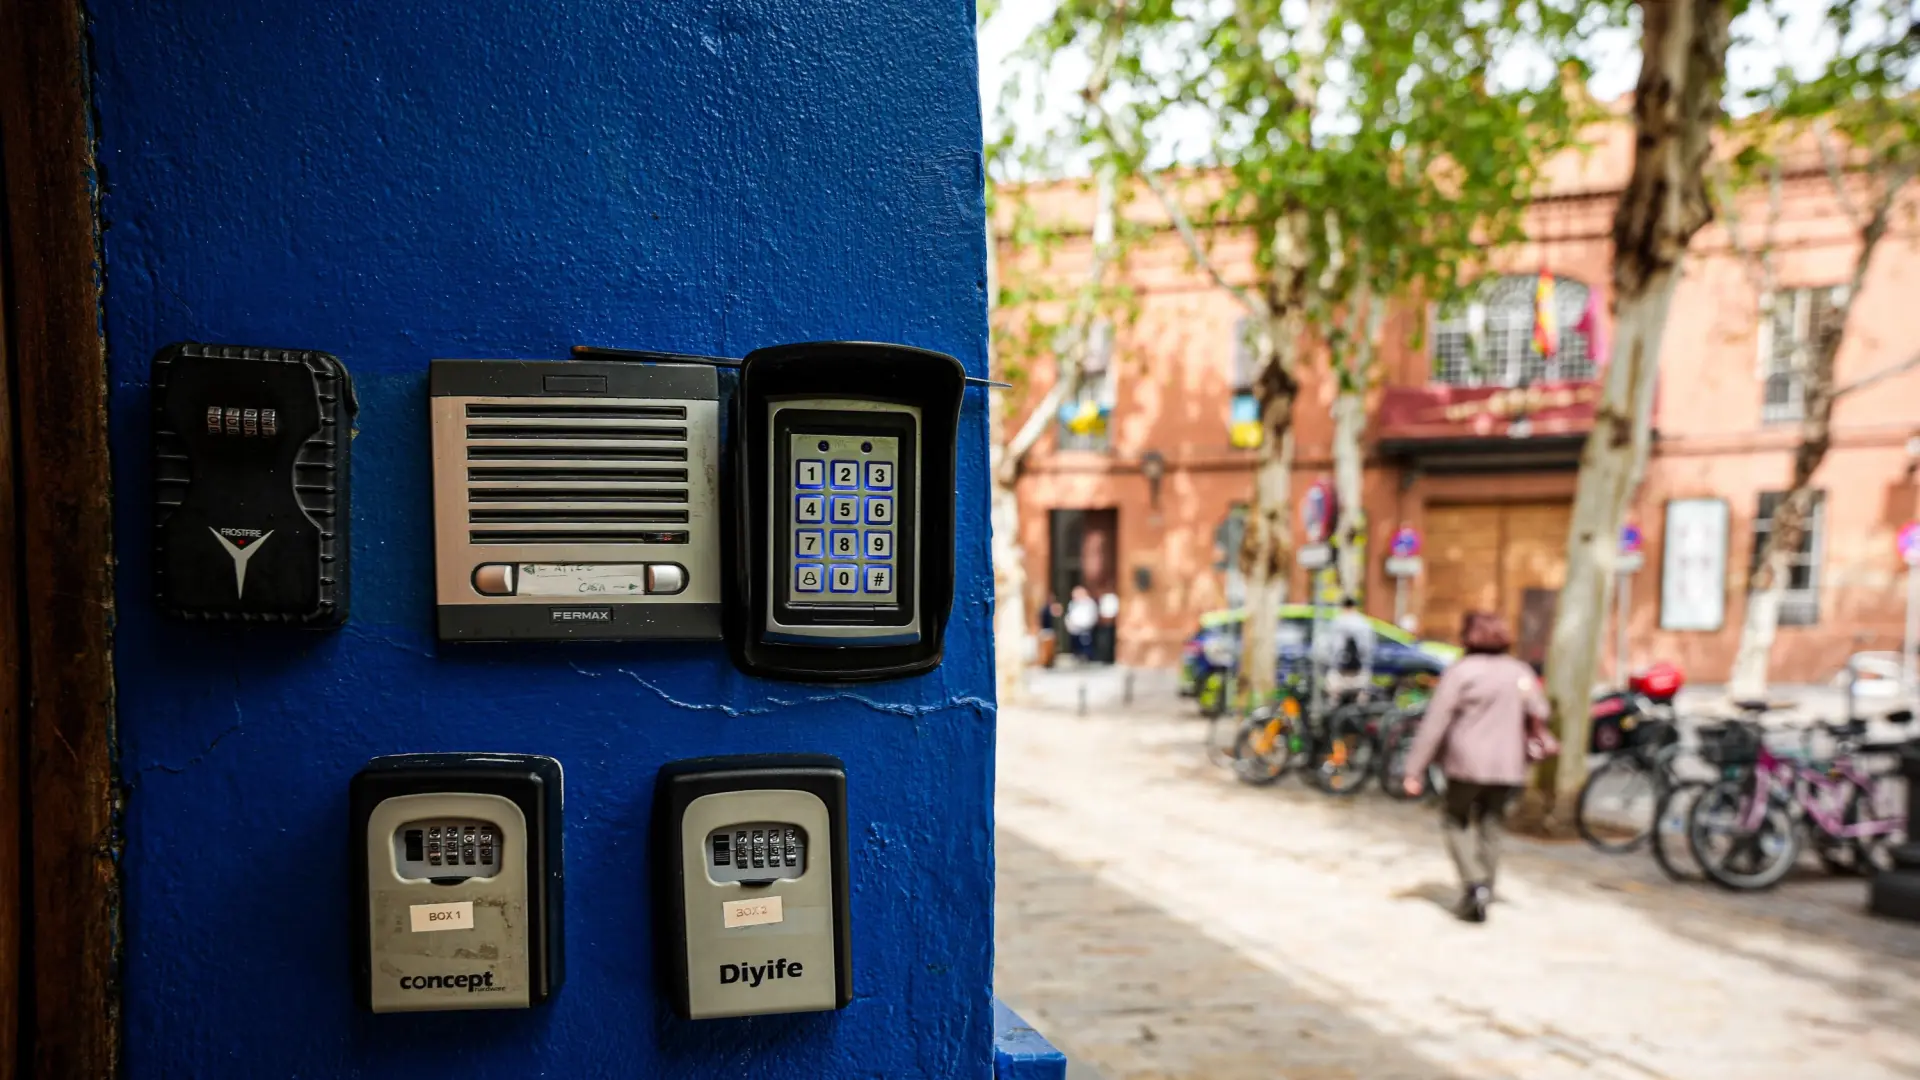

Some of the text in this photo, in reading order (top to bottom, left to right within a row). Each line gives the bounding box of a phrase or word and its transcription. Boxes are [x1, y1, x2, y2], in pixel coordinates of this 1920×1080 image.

[806, 466, 885, 483] 1 2 3
[805, 502, 885, 517] 4 5 6
[221, 527, 262, 537] FROSTFIRE
[805, 537, 884, 551] 7 8 9
[839, 571, 885, 586] 0 #
[552, 611, 609, 621] FERMAX
[429, 911, 461, 921] BOX 1
[761, 906, 767, 915] 2
[719, 958, 803, 988] Diyife
[399, 970, 494, 993] concept
